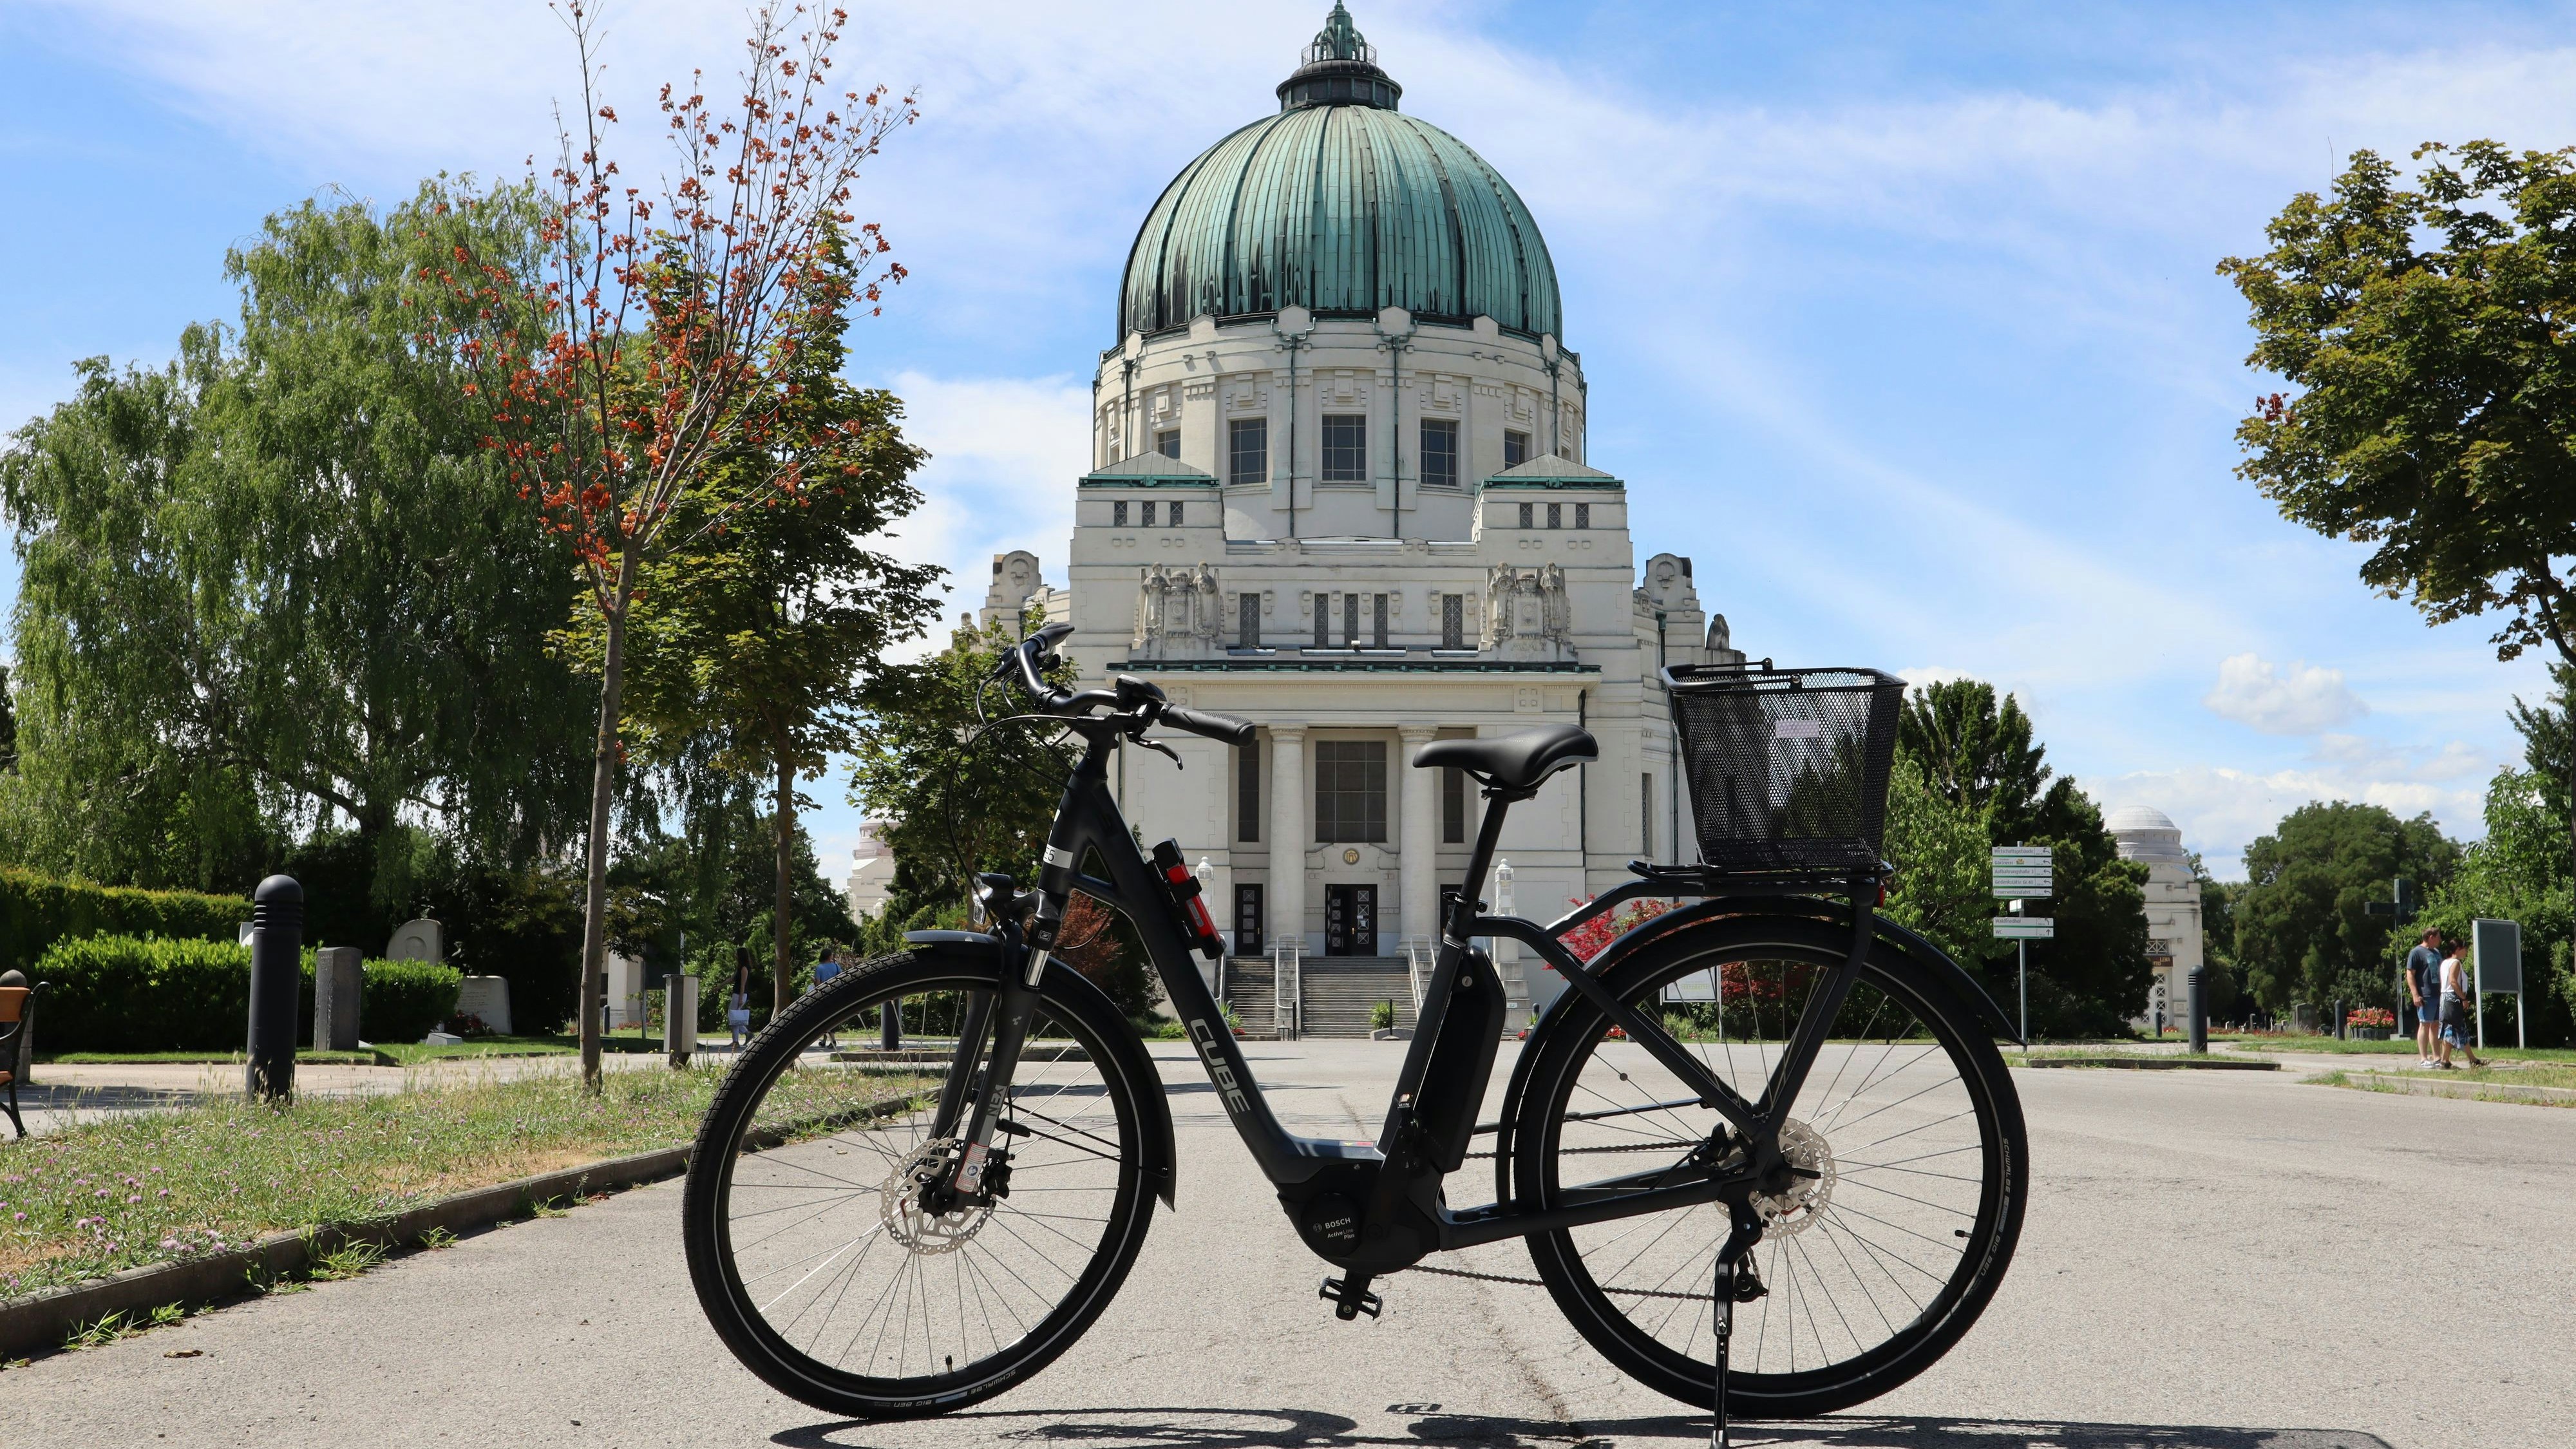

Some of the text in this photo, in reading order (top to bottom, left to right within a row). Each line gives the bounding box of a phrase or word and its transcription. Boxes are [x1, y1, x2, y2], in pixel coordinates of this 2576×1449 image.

[1190, 1018, 1251, 1114] CUBE
[2003, 1137, 2012, 1194] SCHWALBE
[1325, 1217, 1351, 1229] BOSCH
[1980, 1236, 2002, 1276] BIG BEN
[971, 1369, 1016, 1395] SCHWALBE
